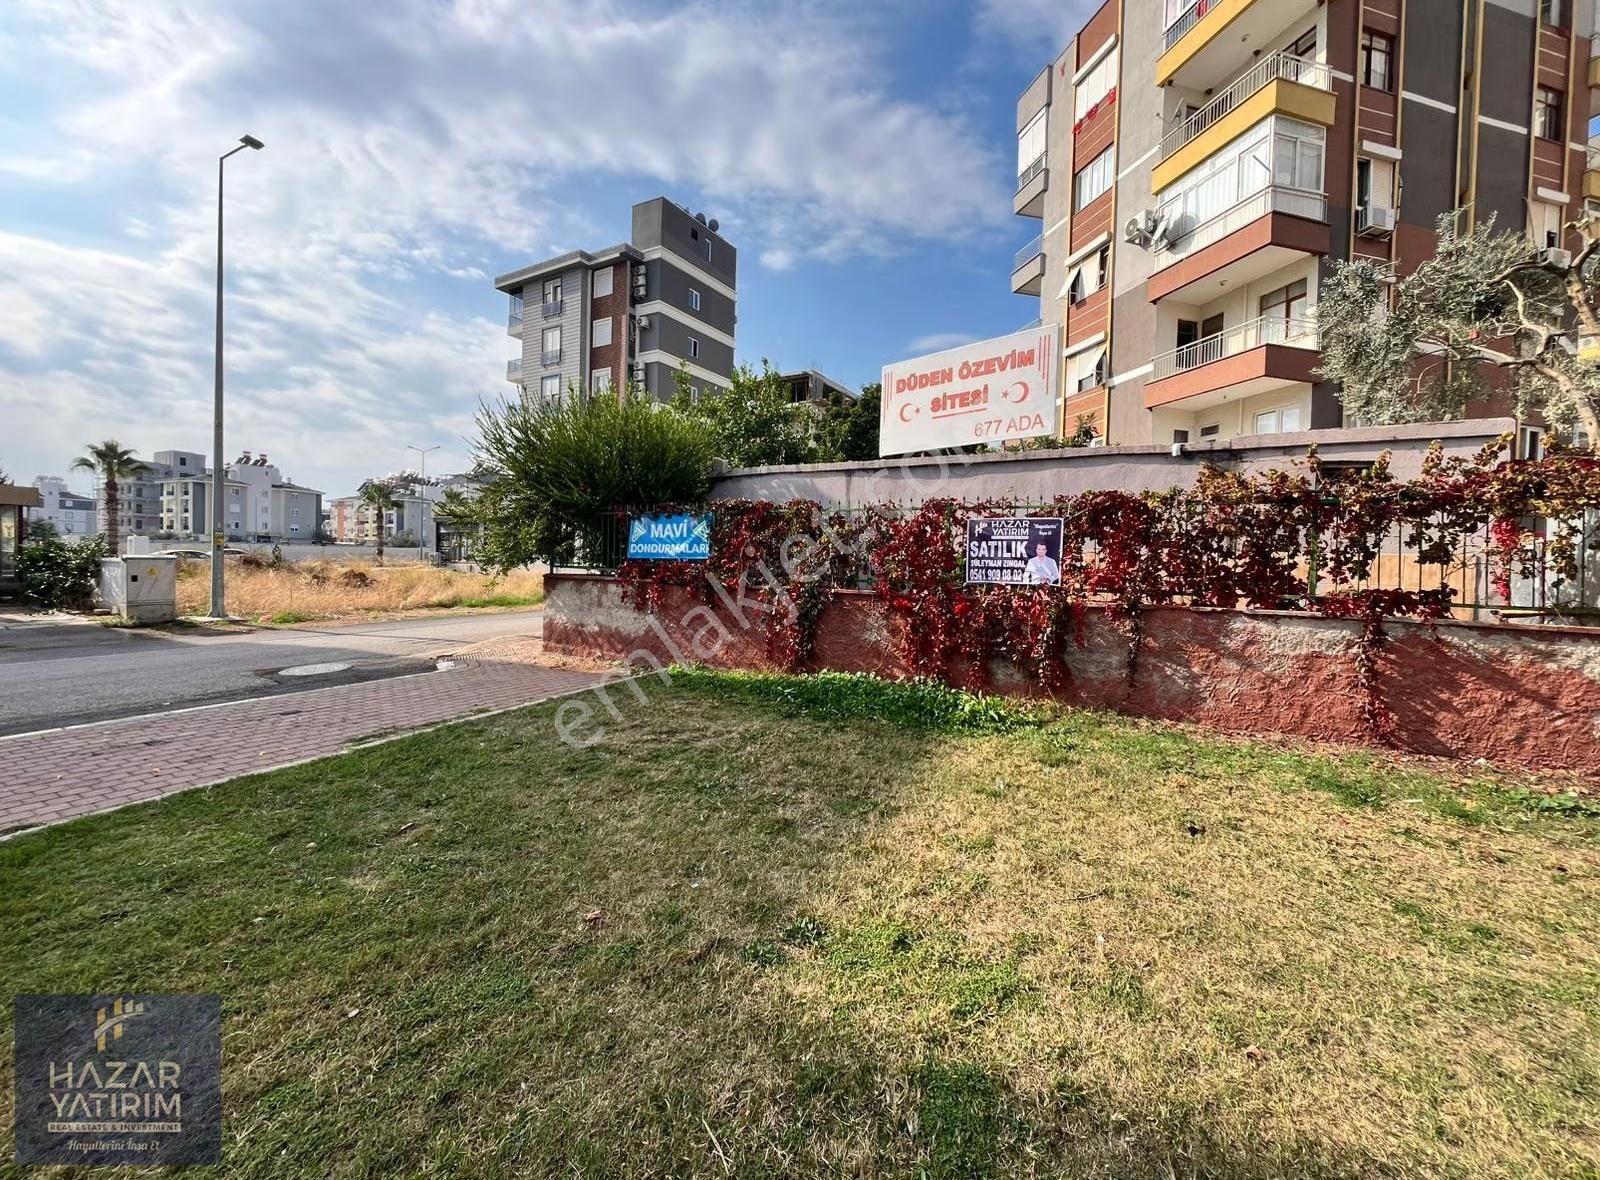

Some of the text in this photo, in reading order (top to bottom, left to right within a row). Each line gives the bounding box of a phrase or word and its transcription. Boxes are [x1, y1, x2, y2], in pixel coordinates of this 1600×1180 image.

[896, 349, 1035, 394] DÜDEN ÖZEVİM
[930, 384, 989, 413] SİTESİ
[974, 413, 1044, 437] 677 ADA
[650, 519, 688, 538] MAVİ
[991, 520, 1030, 528] HAZAR
[992, 528, 1029, 536] YATIRIM
[970, 541, 1028, 558] SATILIK
[970, 569, 986, 580] 0541
[1013, 570, 1023, 581] 02
